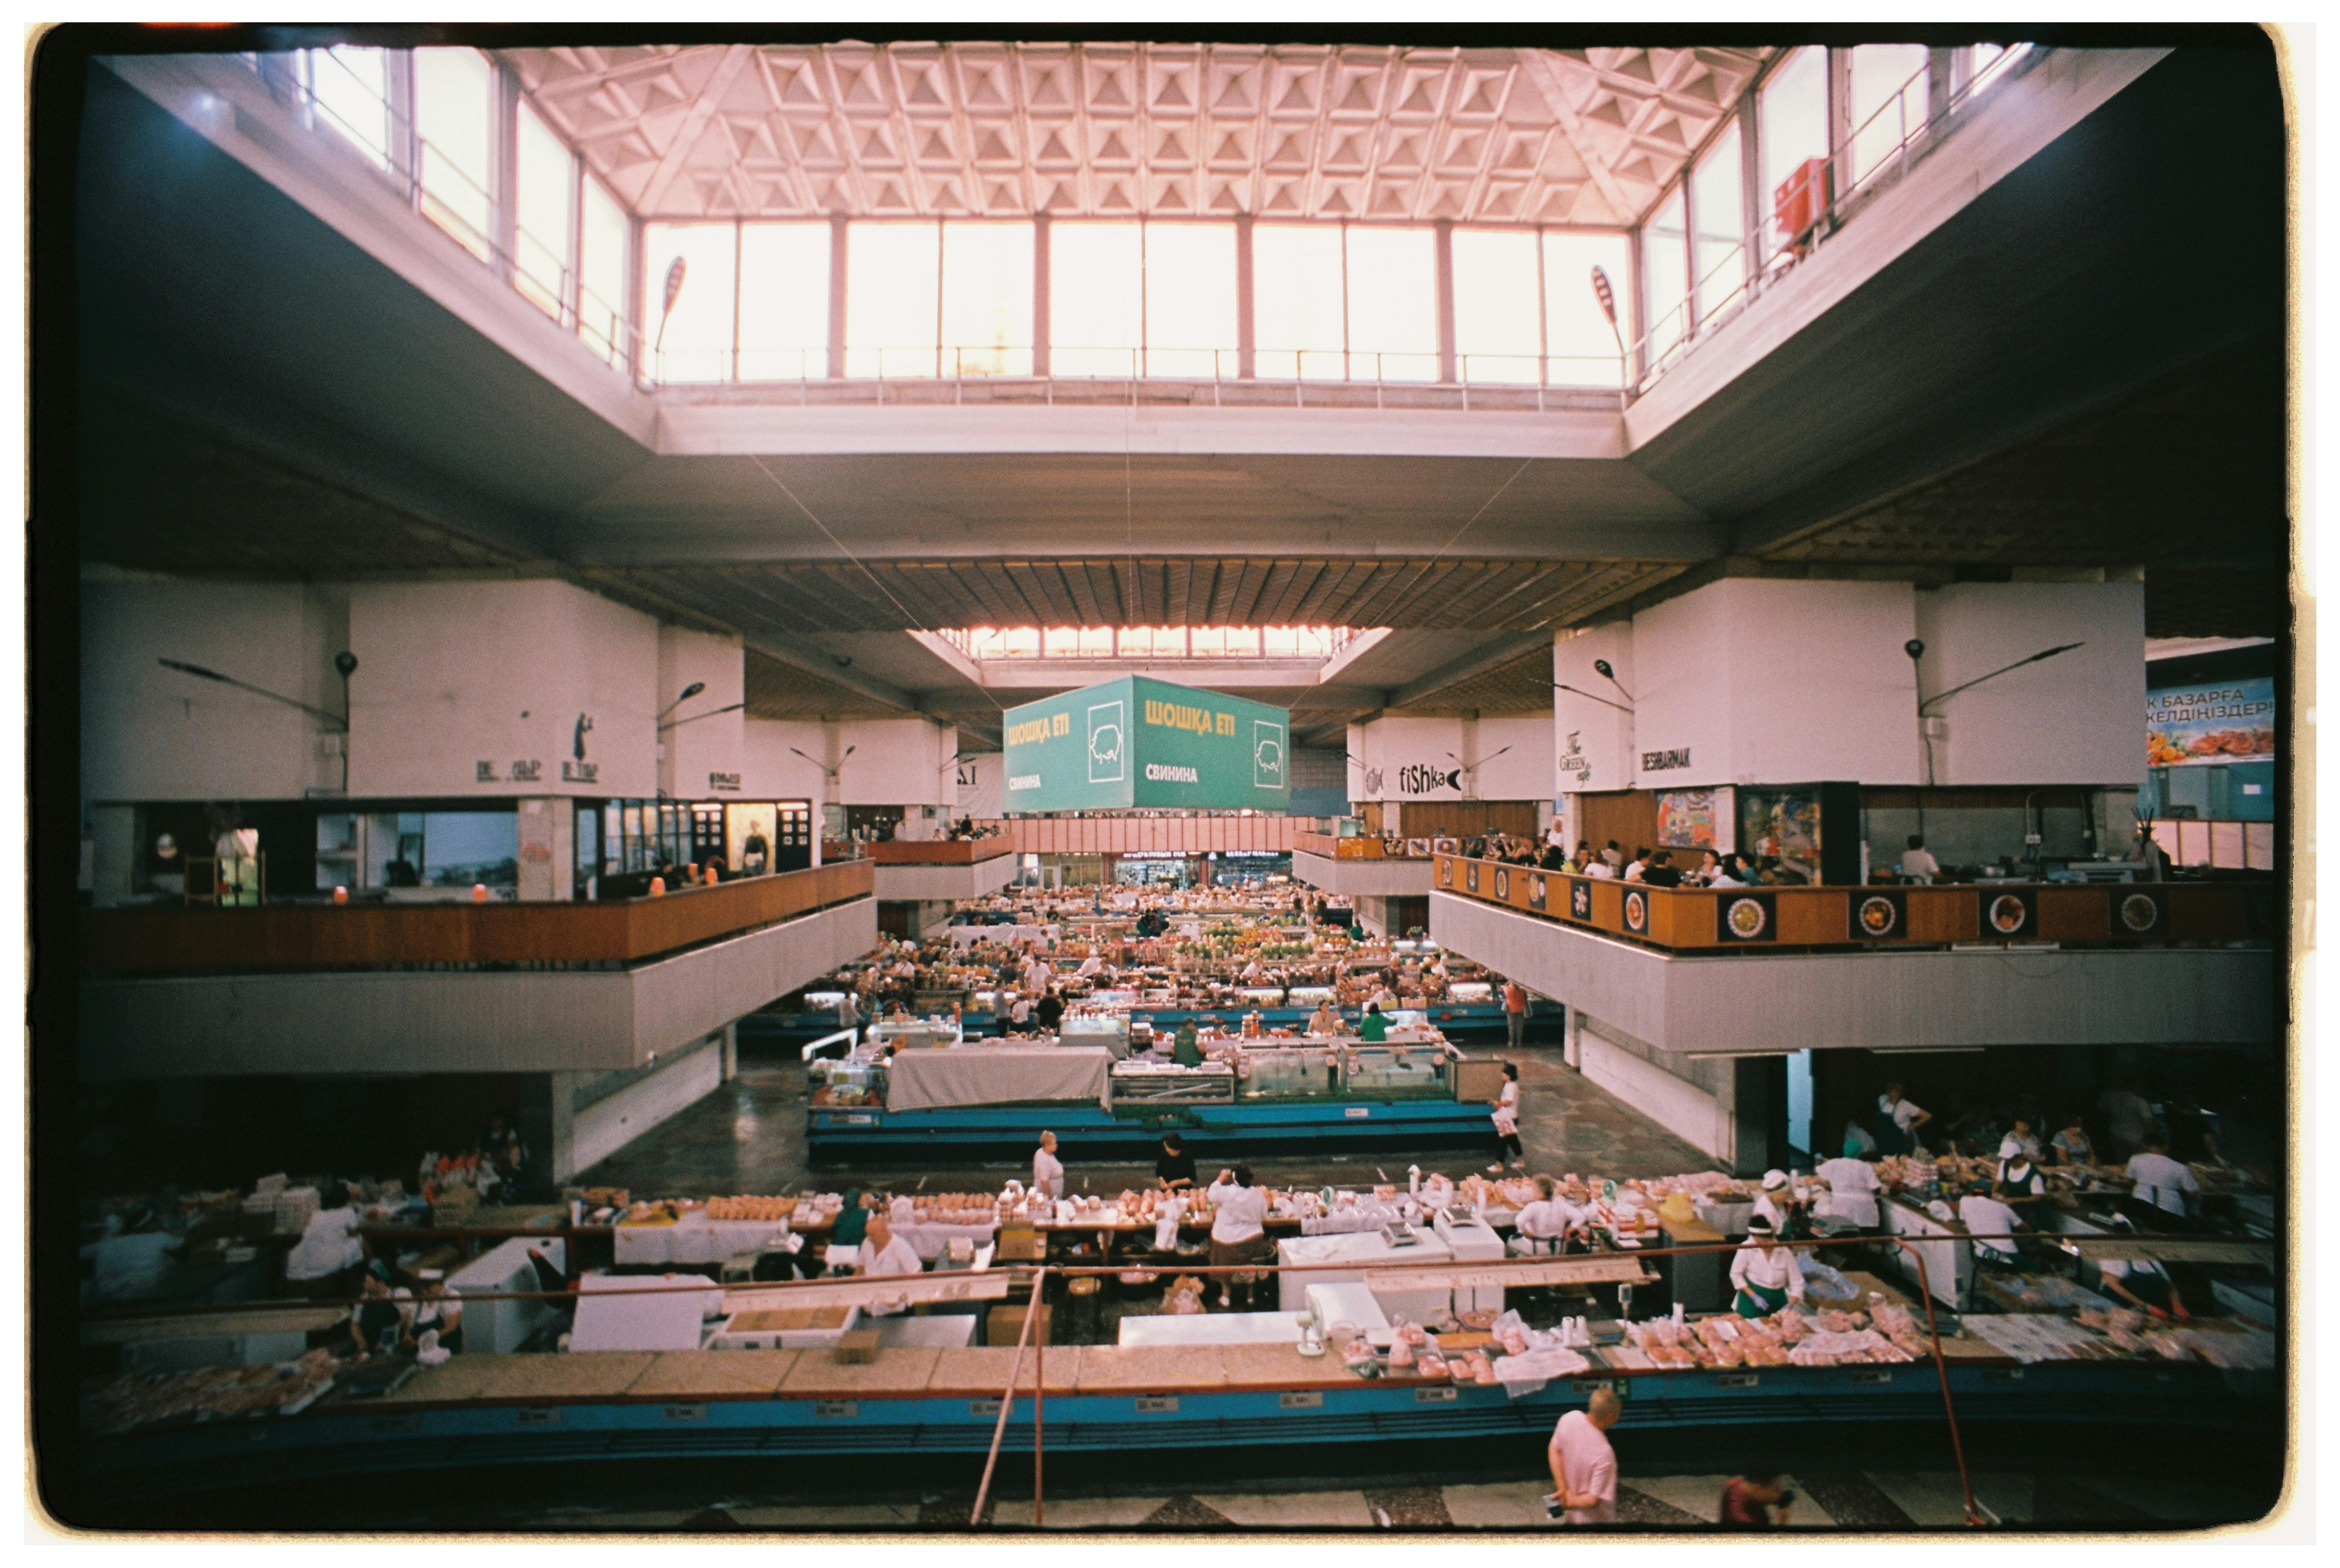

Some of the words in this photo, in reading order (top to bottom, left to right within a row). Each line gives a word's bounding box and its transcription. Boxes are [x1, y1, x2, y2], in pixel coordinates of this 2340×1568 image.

[2162, 689, 2244, 708] БАЗАРҒА
[1145, 700, 1212, 736] ШОШҚА
[1216, 712, 1235, 736] ЕТІ
[1009, 717, 1050, 744] ШОШҚА
[1641, 747, 1690, 772] BESHBARMAK
[1009, 774, 1041, 791] СВИНИНА
[1146, 763, 1198, 782] СВИНИНА
